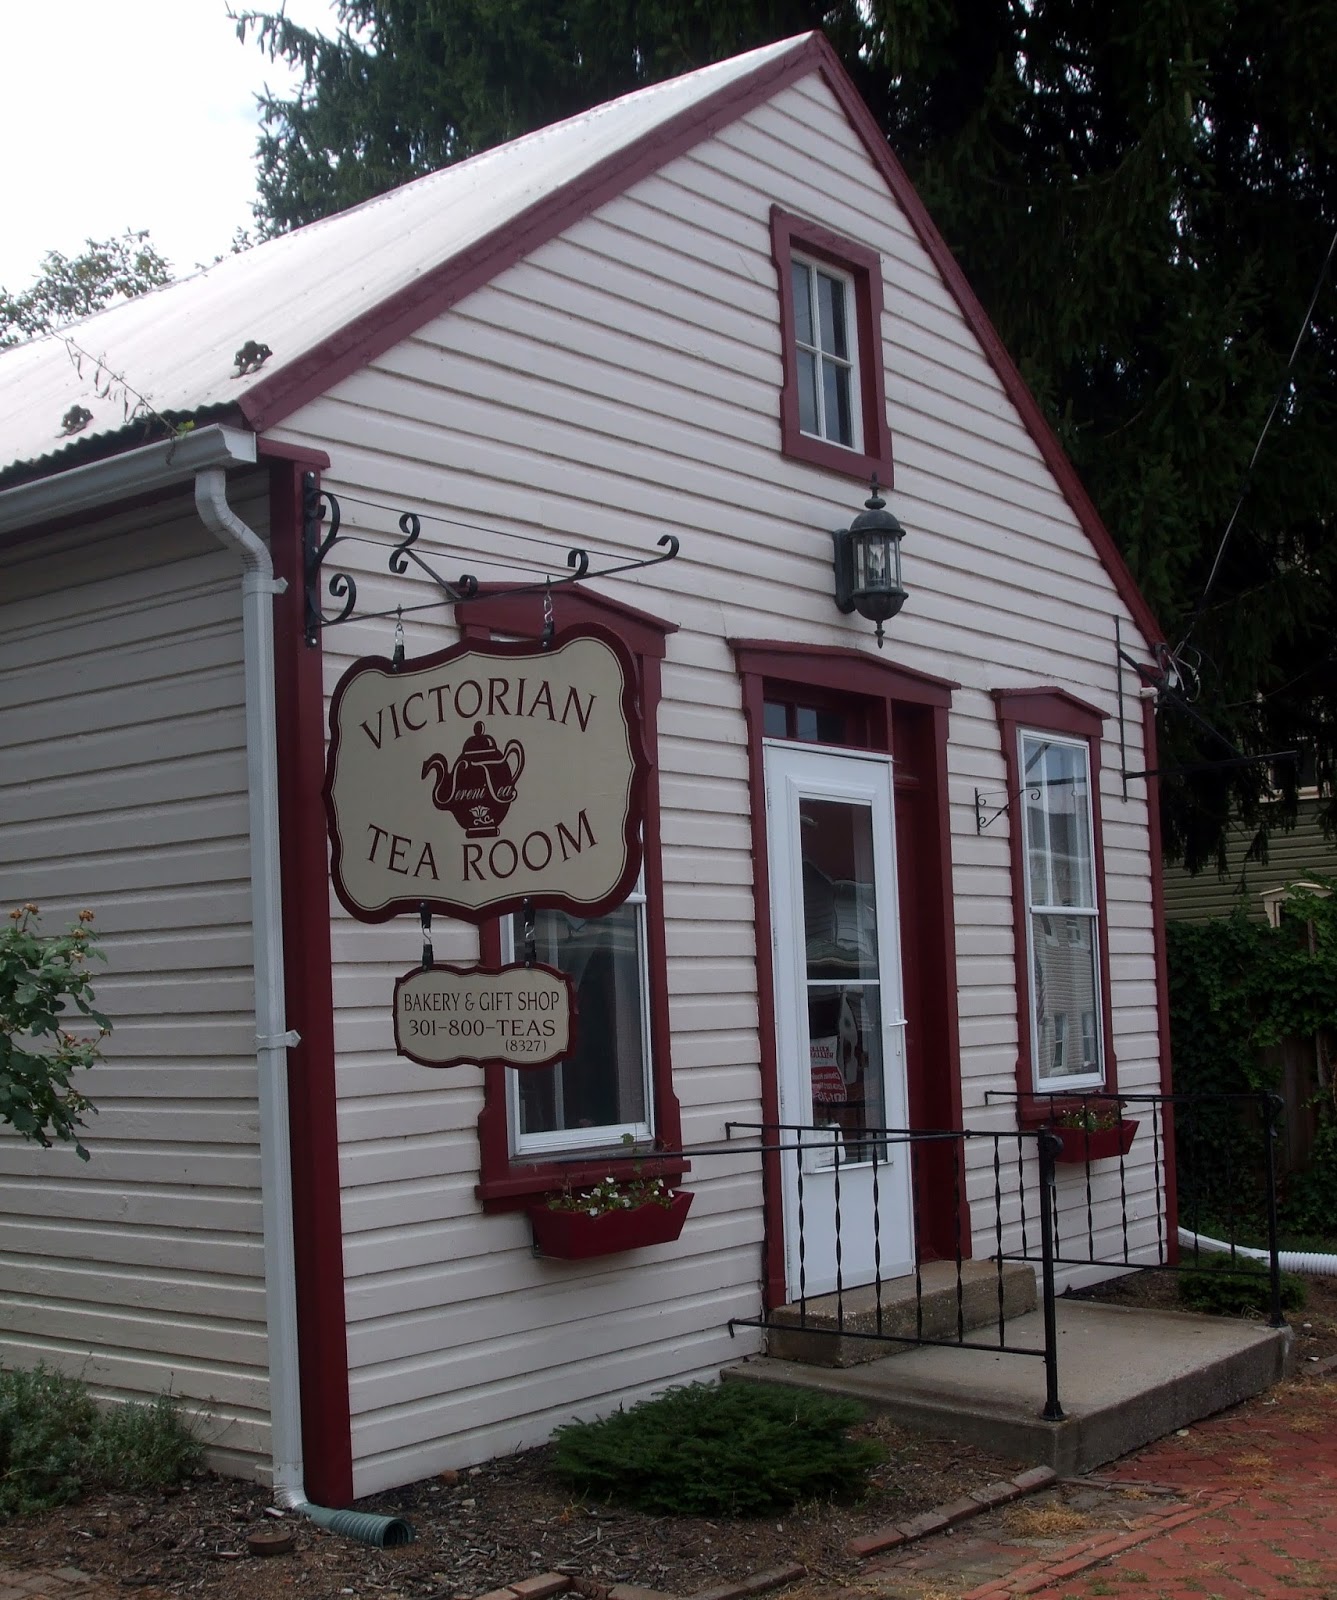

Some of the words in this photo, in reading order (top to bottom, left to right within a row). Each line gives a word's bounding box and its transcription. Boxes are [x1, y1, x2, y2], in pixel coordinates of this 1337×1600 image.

[359, 677, 597, 750] VICTORIAN
[366, 824, 440, 881] TEA
[461, 808, 599, 882] ROOM
[404, 993, 460, 1012] BAKERY
[464, 993, 475, 1011] &
[479, 991, 513, 1011] GIFT
[517, 991, 559, 1011] SHOP
[409, 1019, 555, 1037] 301-800-TEAS
[505, 1039, 547, 1052] (8327)
